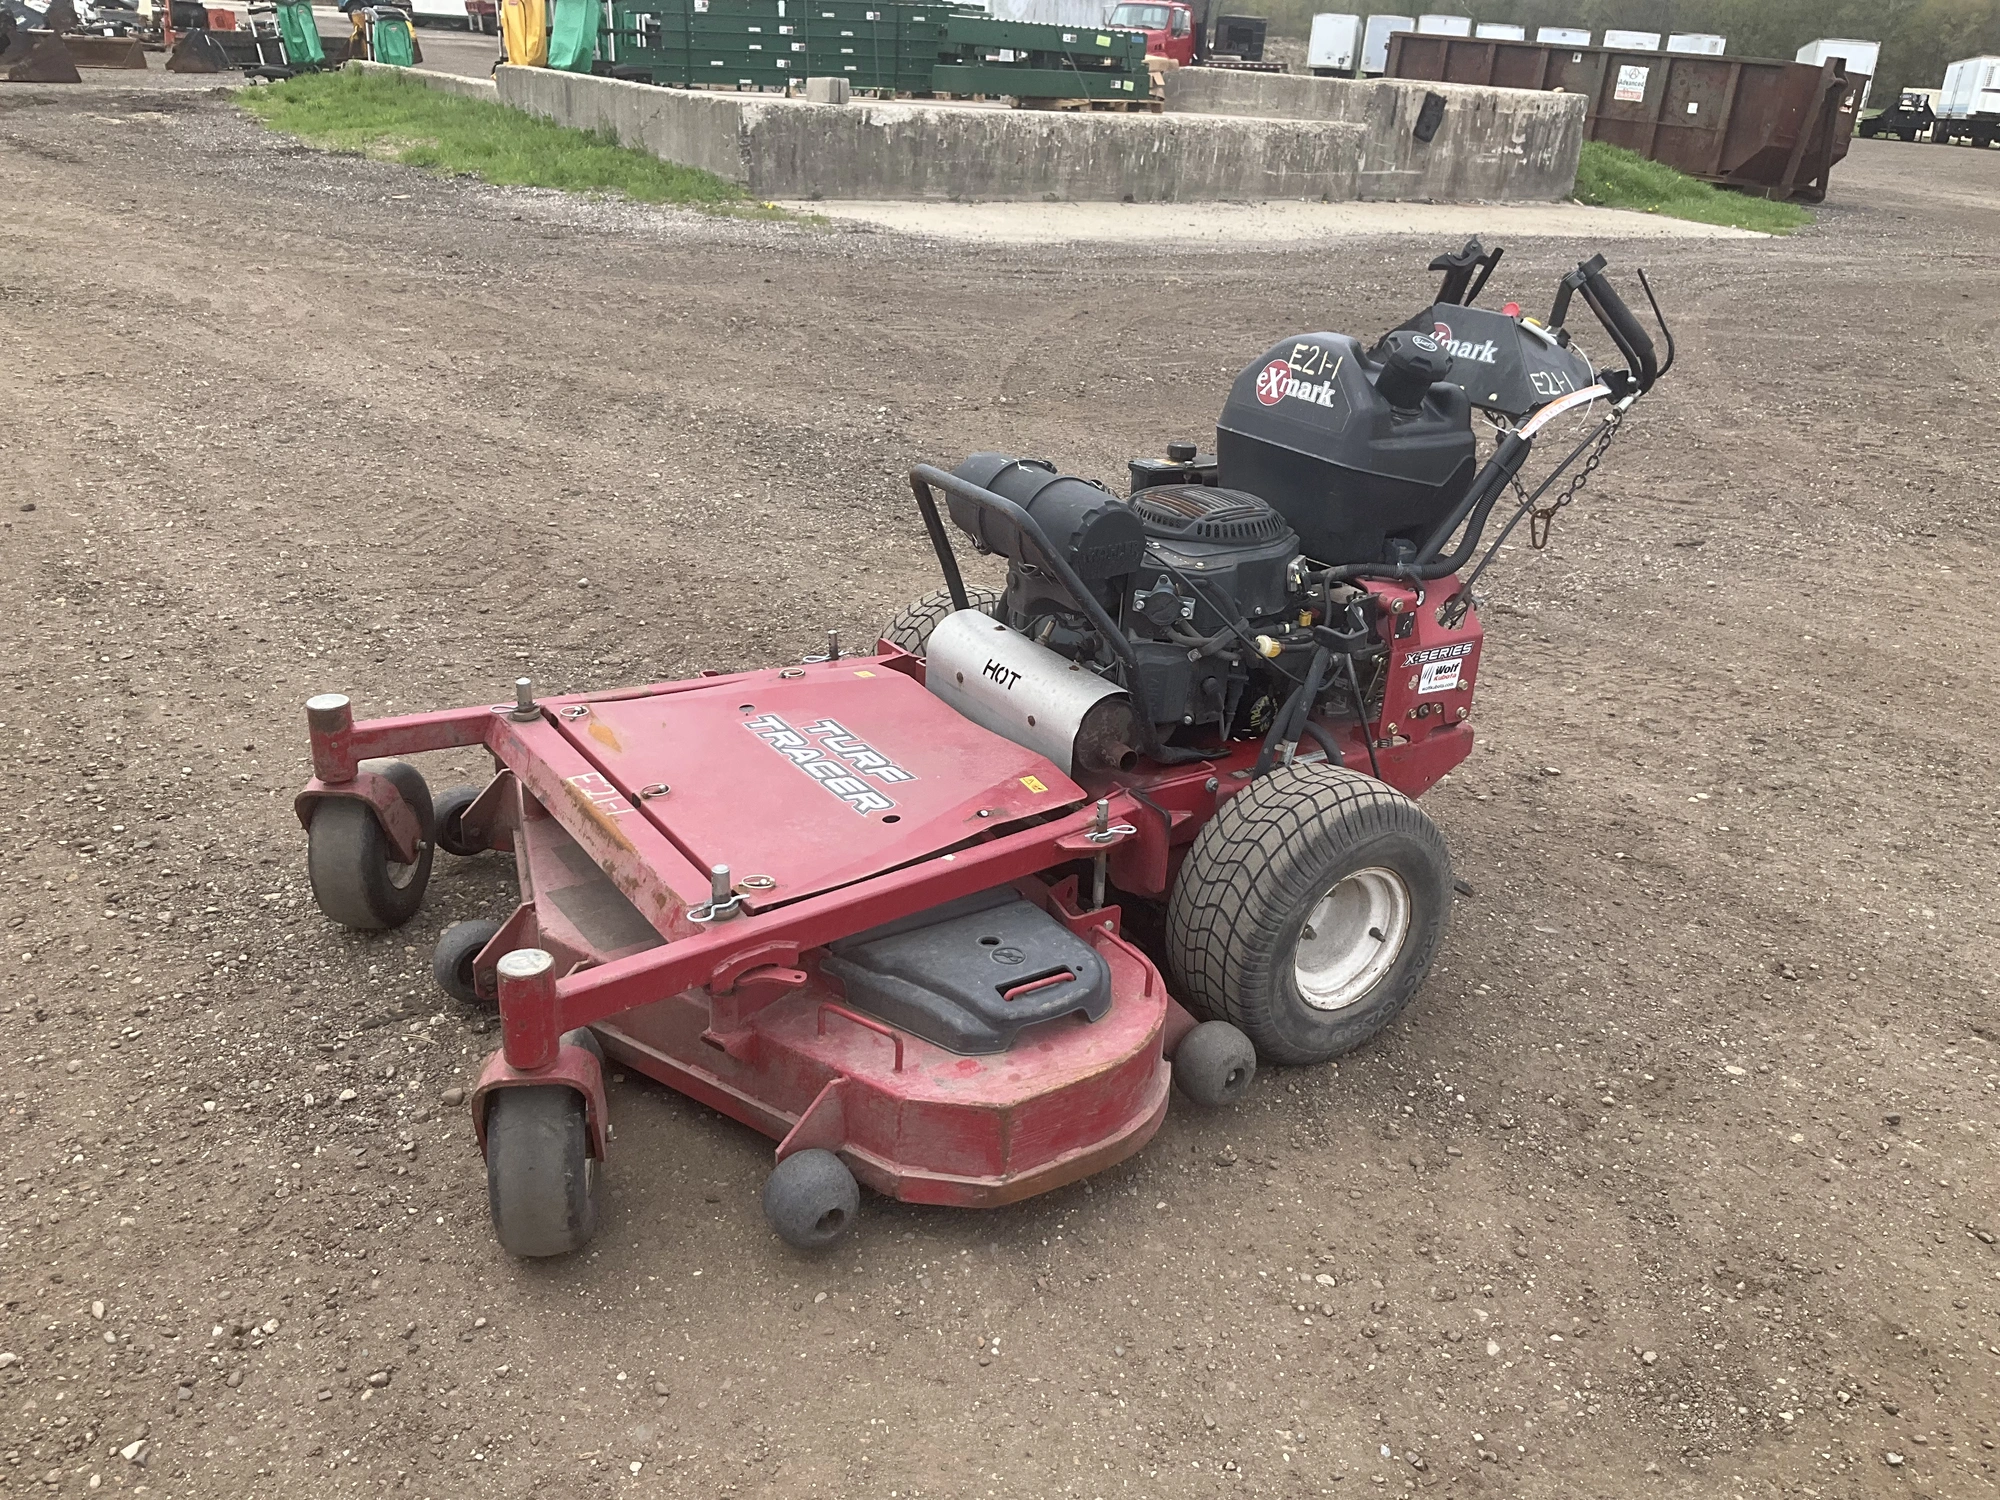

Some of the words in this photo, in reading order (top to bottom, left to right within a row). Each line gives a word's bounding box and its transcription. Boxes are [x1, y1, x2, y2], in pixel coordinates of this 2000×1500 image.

[1429, 331, 1499, 364] mark
[982, 658, 1022, 691] HOT
[1433, 673, 1457, 681] Kubota
[1435, 663, 1460, 675] Wolf
[743, 714, 895, 816] TRACER
[802, 718, 918, 784] TURF
